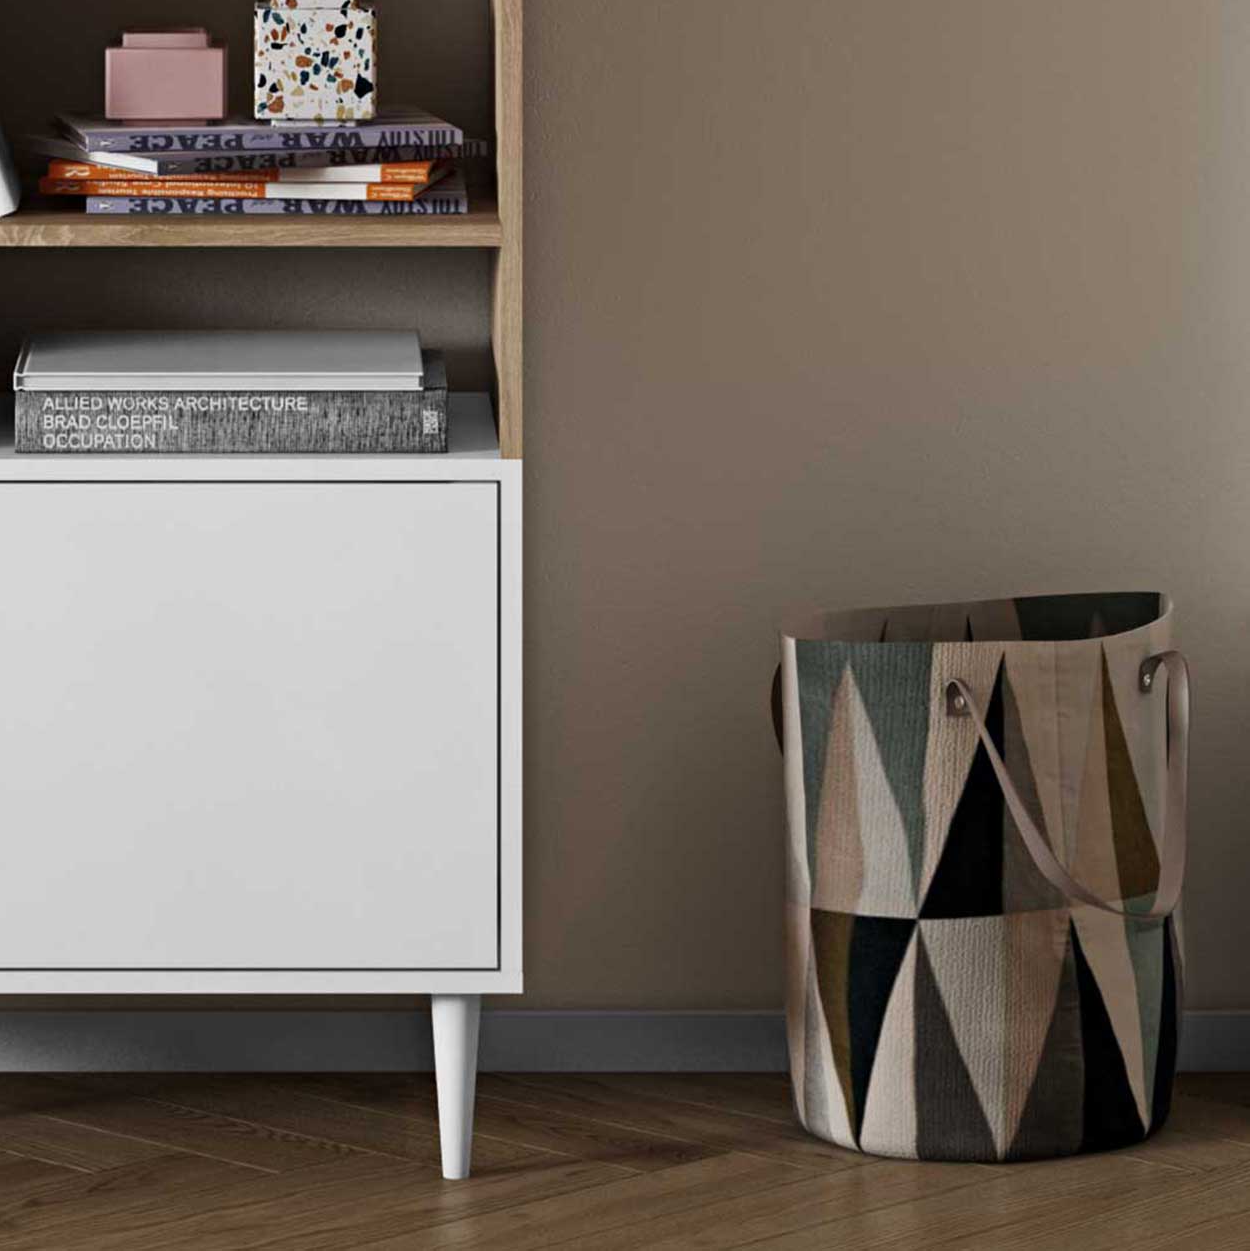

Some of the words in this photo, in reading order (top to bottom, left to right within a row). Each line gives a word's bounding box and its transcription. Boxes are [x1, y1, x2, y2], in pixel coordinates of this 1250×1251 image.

[129, 133, 244, 150] PEACE
[281, 132, 366, 148] WAR
[193, 153, 297, 172] PEACE
[129, 198, 245, 214] PEACE
[282, 199, 367, 214] WAR
[43, 397, 103, 411] ALLIED
[107, 397, 170, 411] WORKS
[173, 397, 309, 411] ARCHITECTURE
[43, 414, 92, 429] BRAD
[96, 414, 179, 429] CLOEPFIL
[43, 433, 157, 449] OCCUPATION
